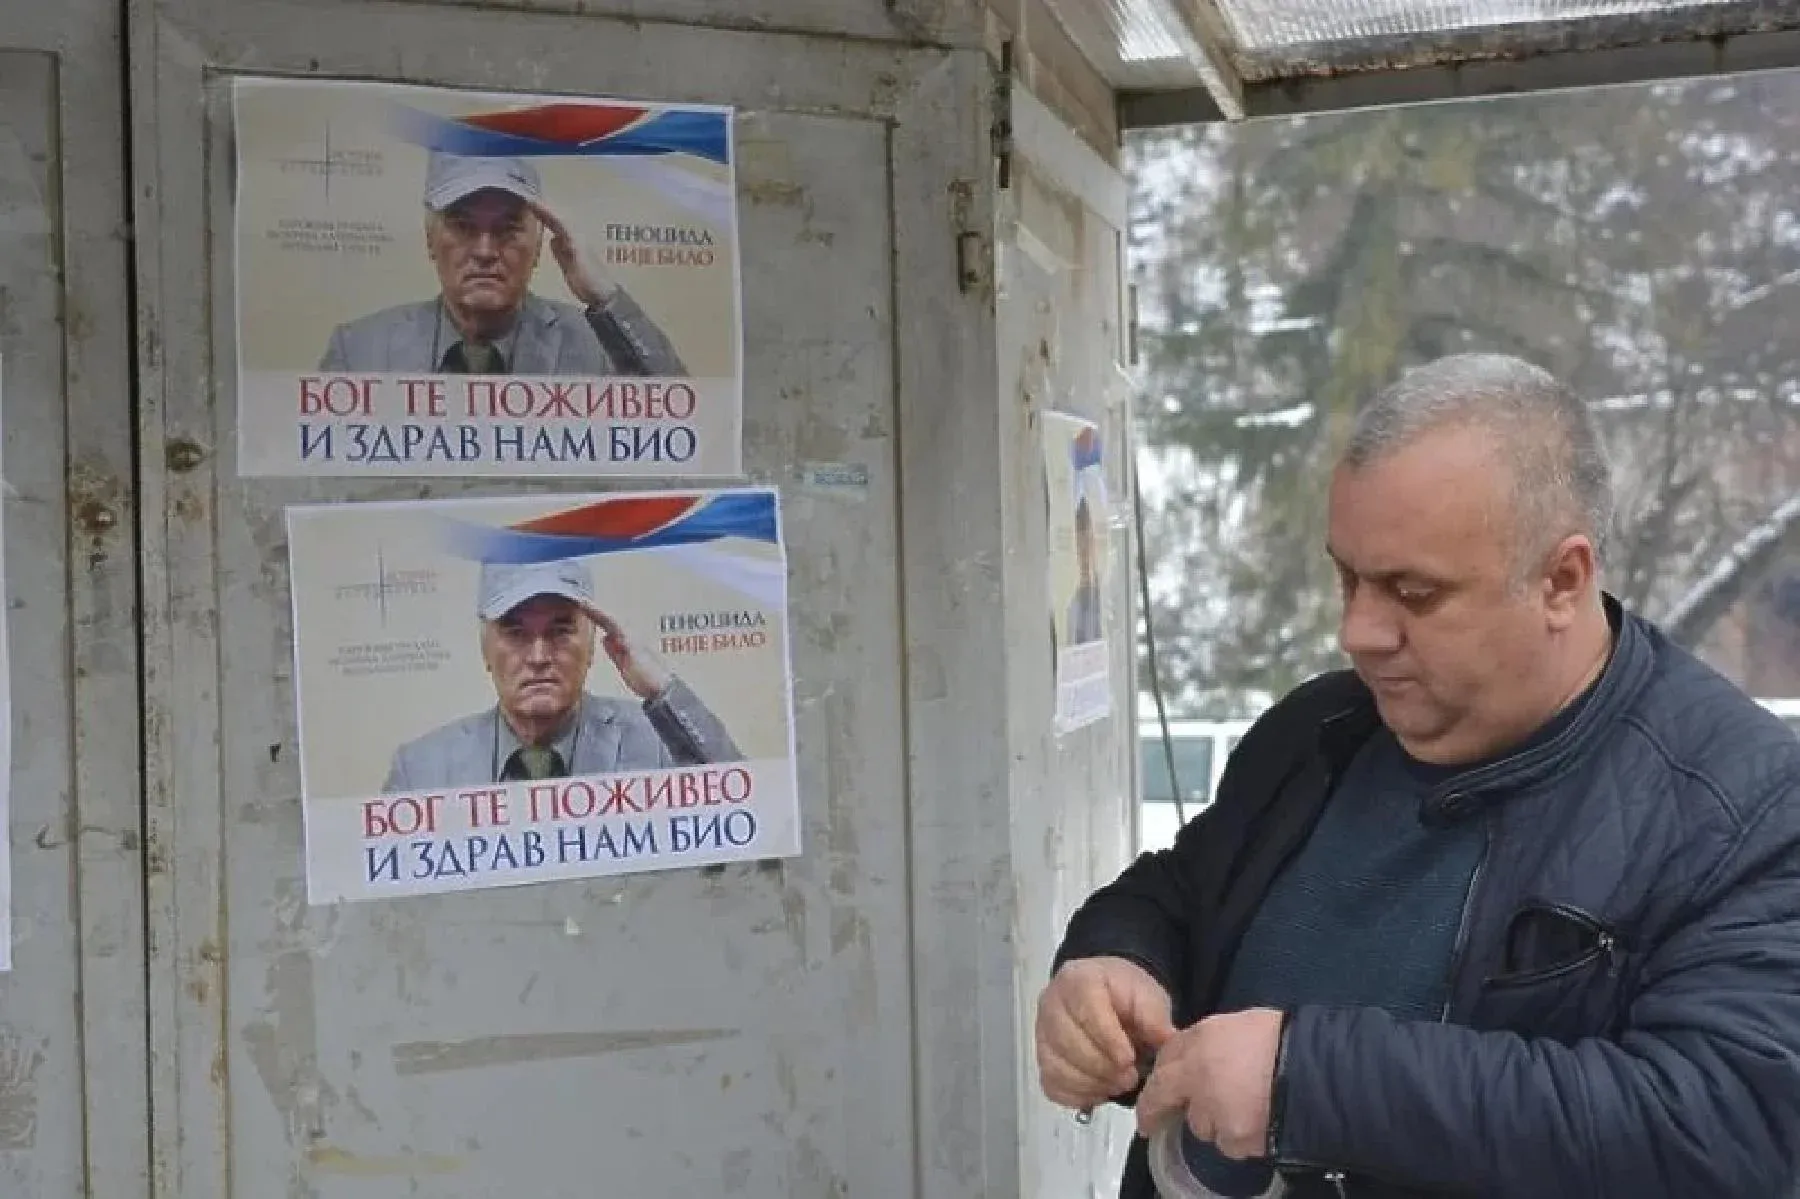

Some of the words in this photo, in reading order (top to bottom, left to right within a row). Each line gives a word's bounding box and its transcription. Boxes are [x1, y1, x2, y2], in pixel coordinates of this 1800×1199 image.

[605, 223, 714, 246] ГЕНОЦИДА
[605, 246, 656, 265] НИЈЕ
[658, 248, 714, 266] БИЛО
[300, 377, 382, 417] БОГ
[398, 379, 448, 418] ТЕ
[466, 380, 697, 420] ПОЖИВЕО
[300, 424, 333, 461] И
[346, 424, 481, 464] ЗДРАВ
[494, 424, 597, 462] НАМ
[609, 425, 697, 462] БИО
[659, 610, 767, 633] ГЕНОЦИДА
[660, 634, 708, 653] НИЈЕ
[712, 631, 767, 650] БИЛО
[362, 796, 445, 839] БОГ
[459, 788, 511, 828] ТЕ
[529, 767, 753, 823] ПОЖИВЕО
[366, 845, 401, 883] И
[411, 830, 546, 880] ЗДРАВ
[557, 819, 660, 864] НАМ
[669, 809, 758, 854] БИО
